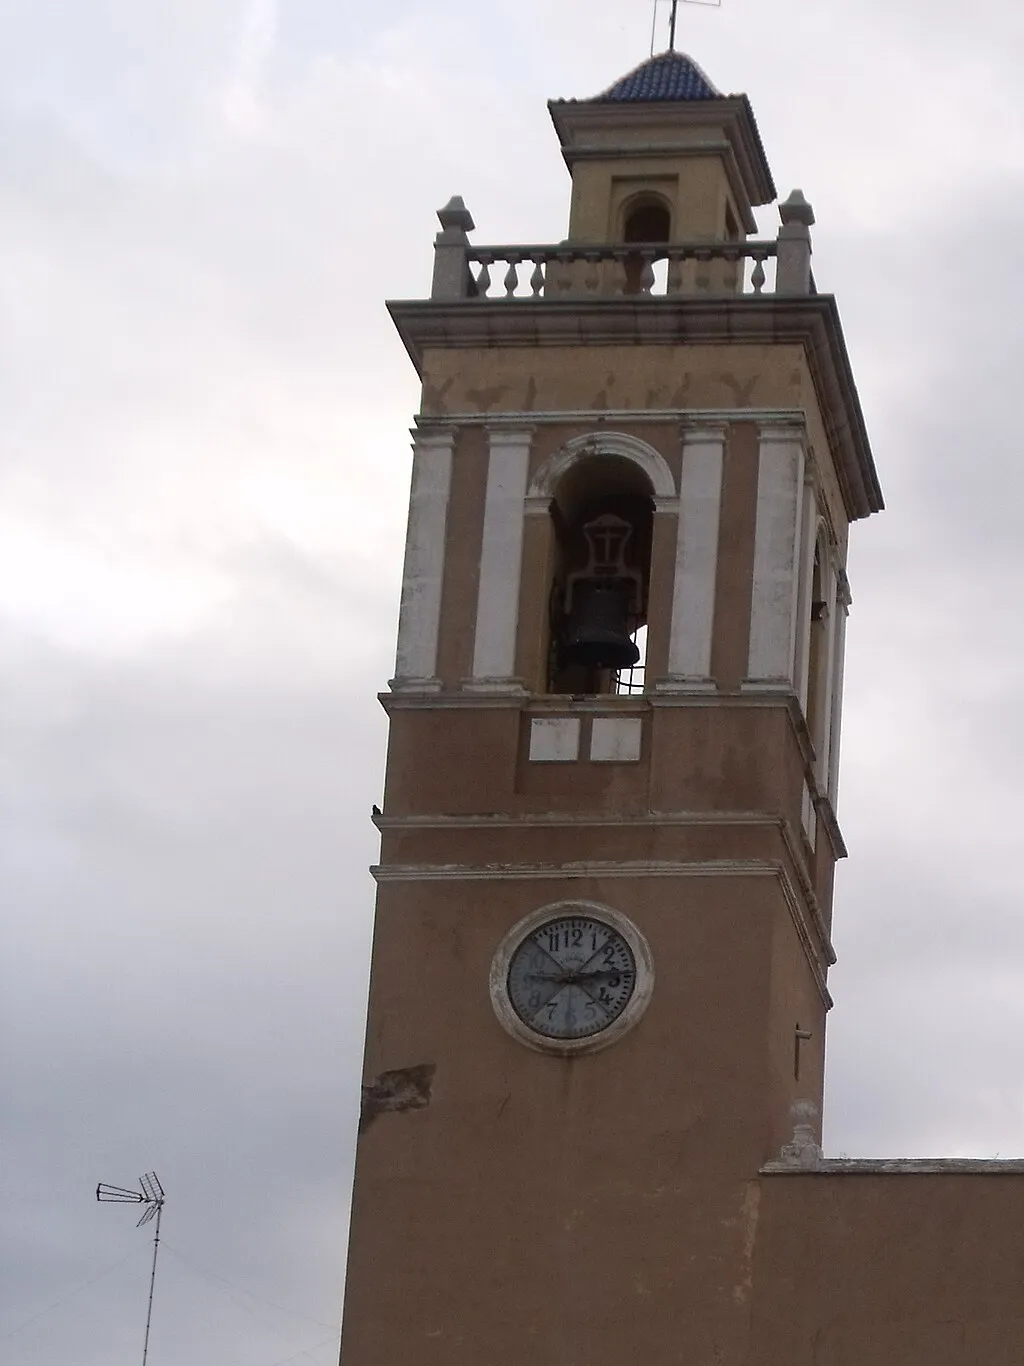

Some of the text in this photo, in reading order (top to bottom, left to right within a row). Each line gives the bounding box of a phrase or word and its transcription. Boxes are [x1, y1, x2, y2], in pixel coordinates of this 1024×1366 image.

[549, 932, 559, 952] 11
[564, 929, 583, 948] 12
[591, 932, 597, 951] 1
[529, 951, 545, 969] 10
[603, 946, 615, 965] 2
[528, 989, 541, 1009] 8
[598, 987, 614, 1006] 4
[544, 1002, 558, 1020] 7
[584, 1001, 597, 1020] 5
